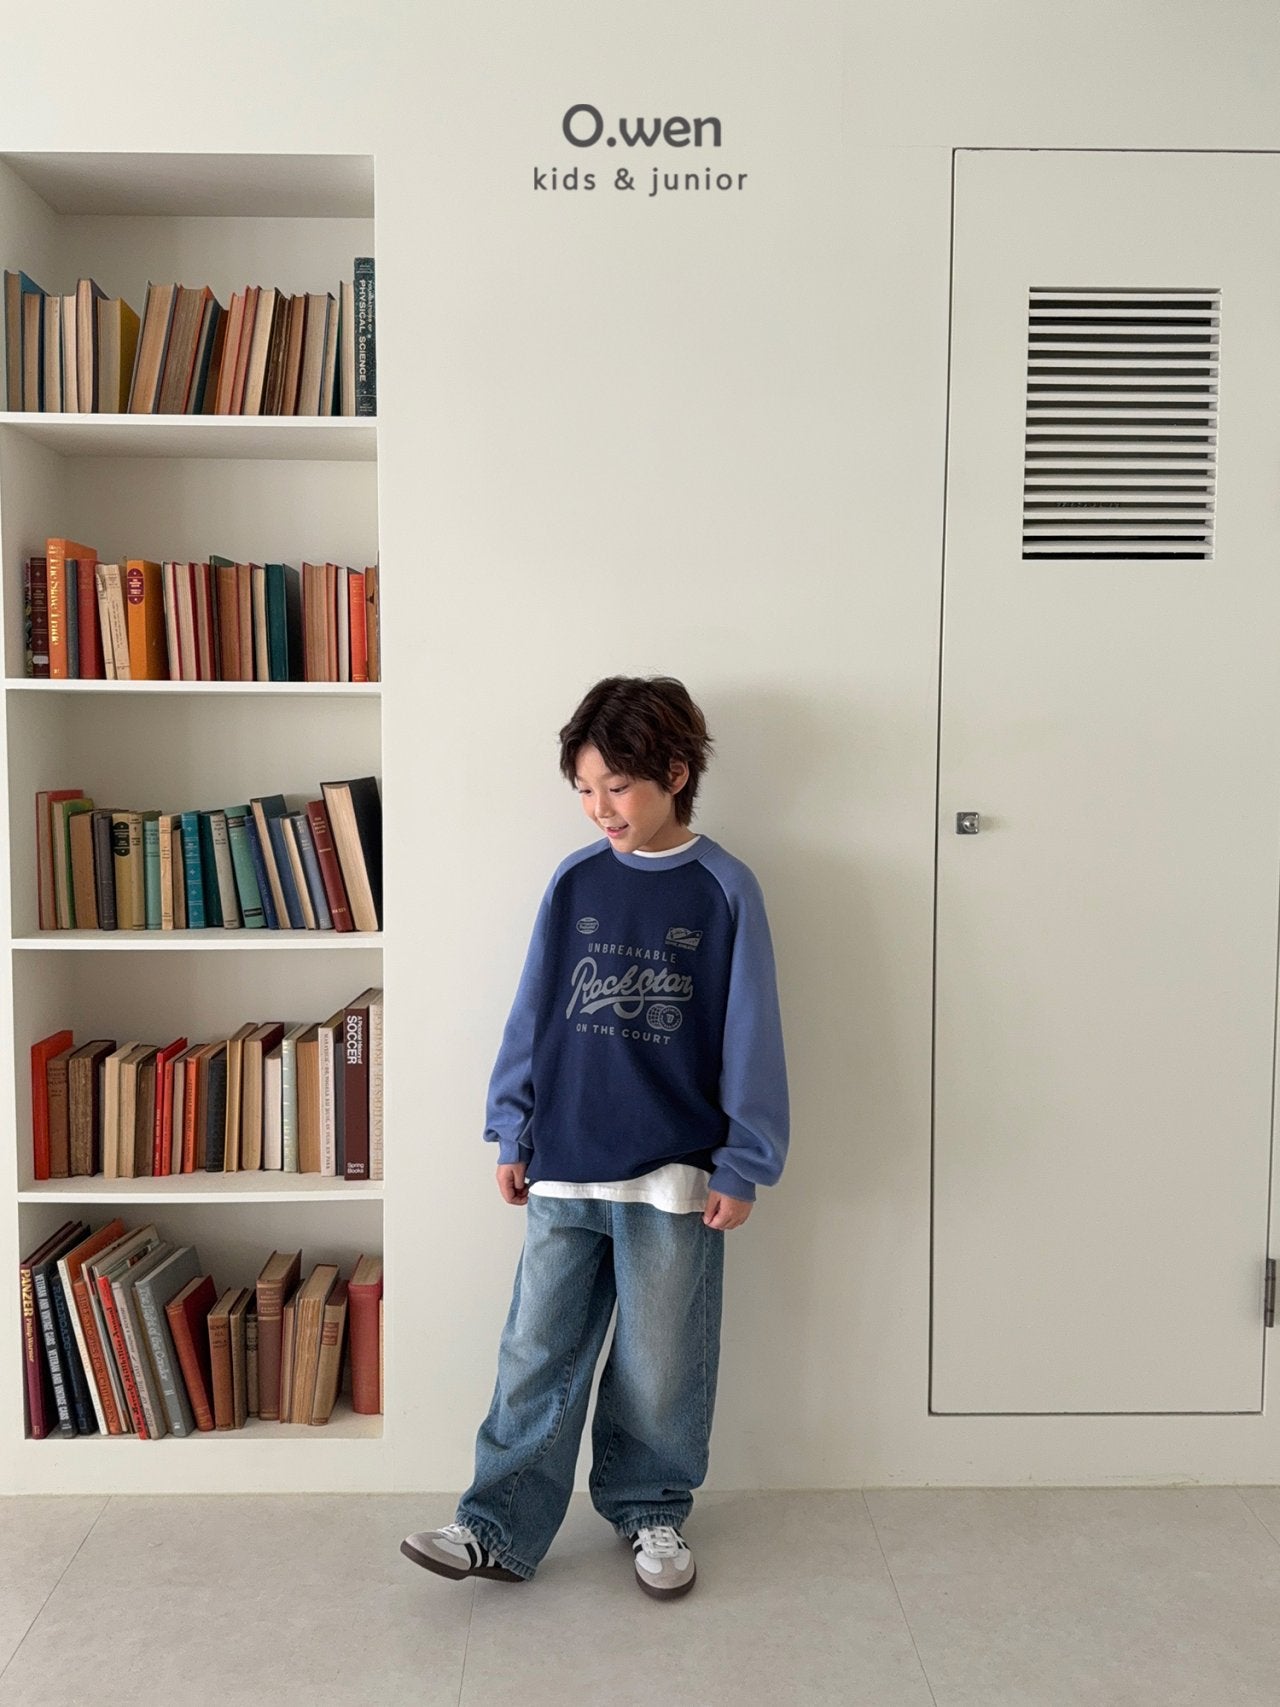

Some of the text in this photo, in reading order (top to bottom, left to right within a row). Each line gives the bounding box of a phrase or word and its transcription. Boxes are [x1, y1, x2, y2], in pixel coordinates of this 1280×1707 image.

[358, 279, 367, 383] PHYSICAL SCIENCE
[587, 942, 678, 964] UNBREAKABLE
[346, 1015, 358, 1065] SOCCER
[576, 1023, 671, 1045] ON THE COURT
[21, 1269, 35, 1363] PANZER Philip Warner
[35, 1273, 55, 1346] VETERAN AND VINTAGE CARS
[53, 1285, 71, 1352] RAILROADS
[48, 1349, 60, 1373] VETERAN
[53, 1373, 63, 1385] AND
[55, 1385, 67, 1406] VINTAGE
[59, 1406, 70, 1420] CARS
